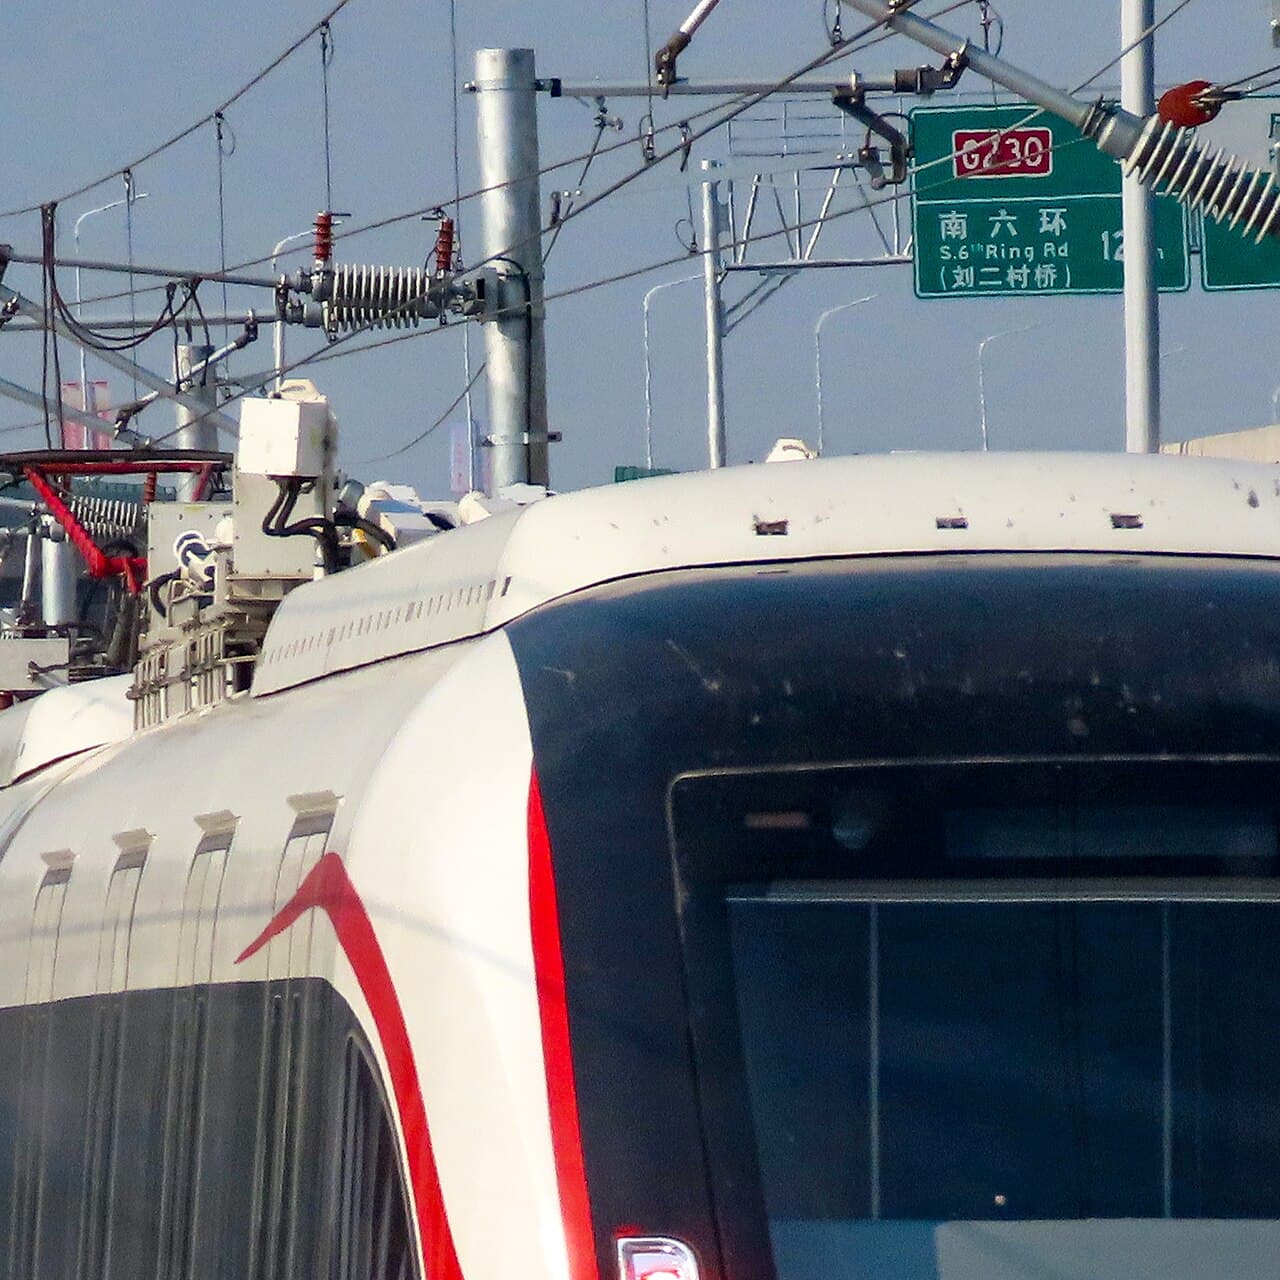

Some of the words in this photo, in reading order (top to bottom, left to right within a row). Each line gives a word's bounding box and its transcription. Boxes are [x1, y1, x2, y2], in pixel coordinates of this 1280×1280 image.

[962, 136, 1043, 170] G230
[938, 208, 1068, 240] 南六环
[986, 243, 1035, 262] Ring
[1044, 241, 1069, 258] Rd
